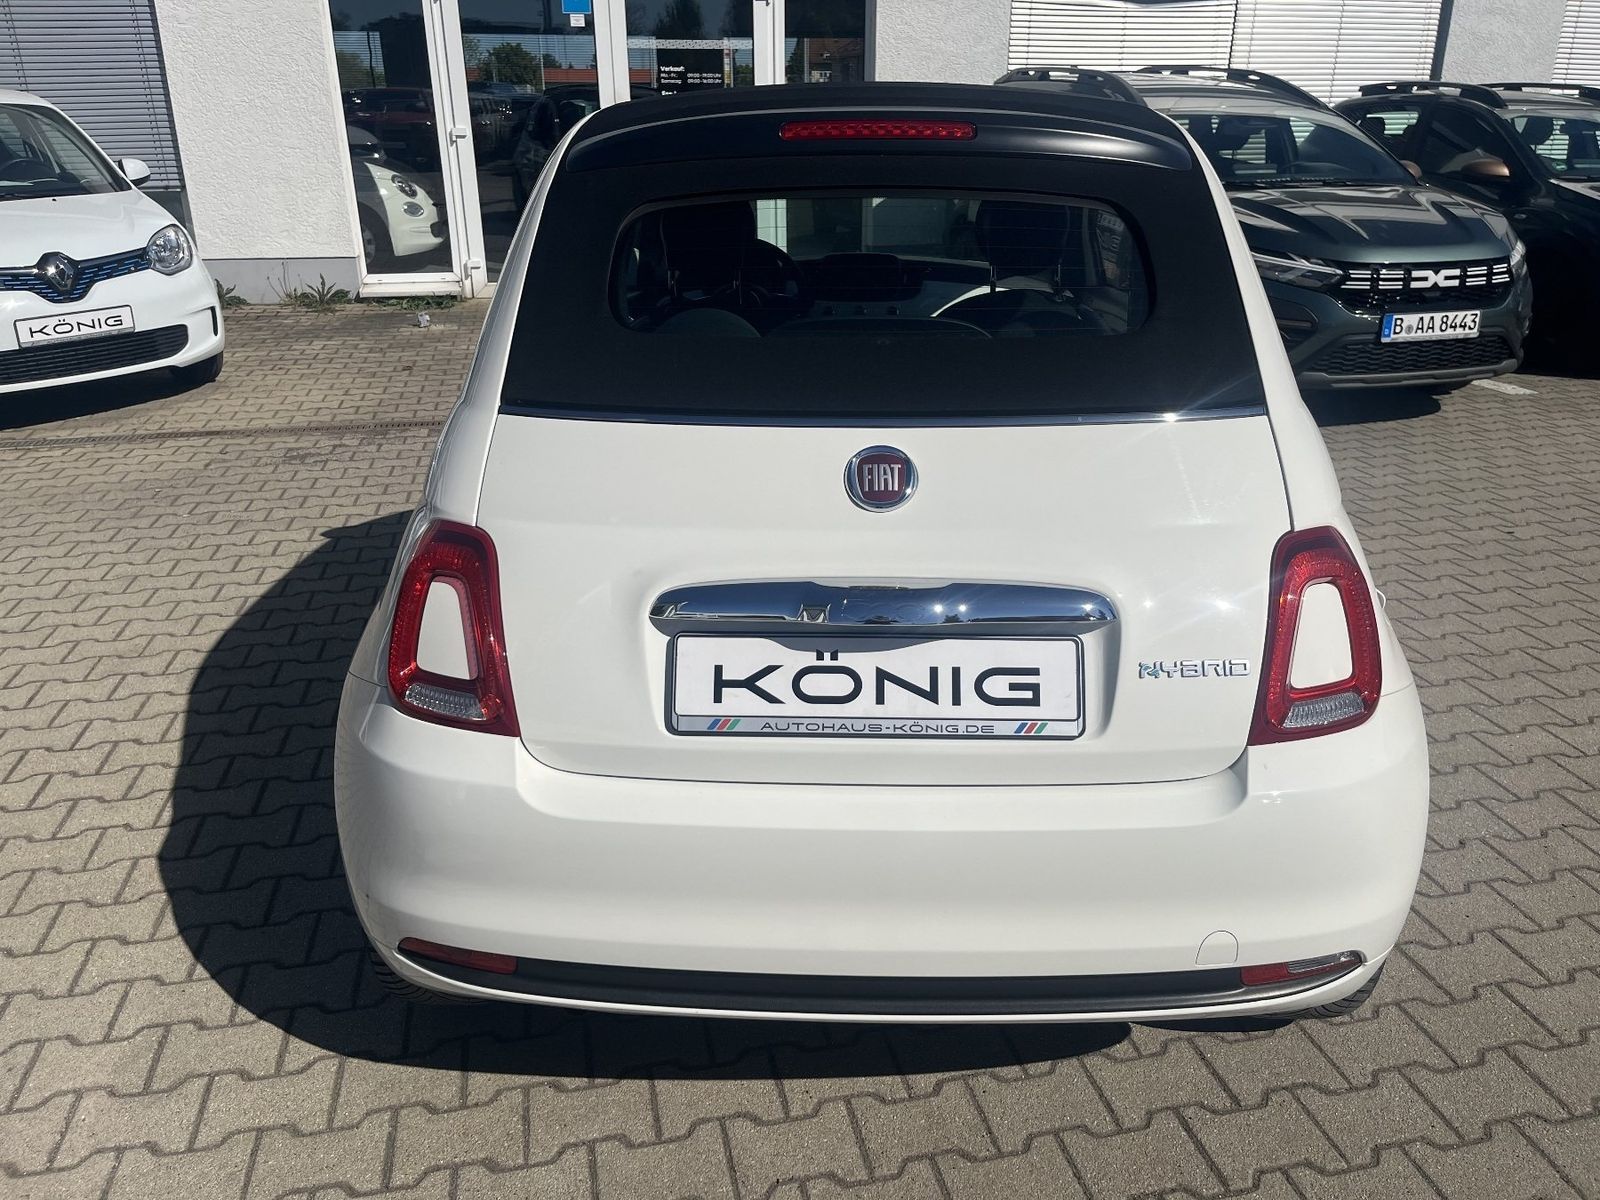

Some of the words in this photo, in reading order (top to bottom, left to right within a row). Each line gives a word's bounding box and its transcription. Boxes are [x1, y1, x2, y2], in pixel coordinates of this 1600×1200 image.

[29, 315, 123, 338] KÖNIG
[1393, 317, 1404, 335] B
[1415, 316, 1435, 334] AA
[1439, 313, 1479, 332] 8443
[862, 463, 902, 492] FIAT
[713, 649, 1041, 707] KÖNIG
[1138, 658, 1251, 679] HYBRID
[760, 721, 995, 735] AUTOHAUS-KÖNIG.DE
